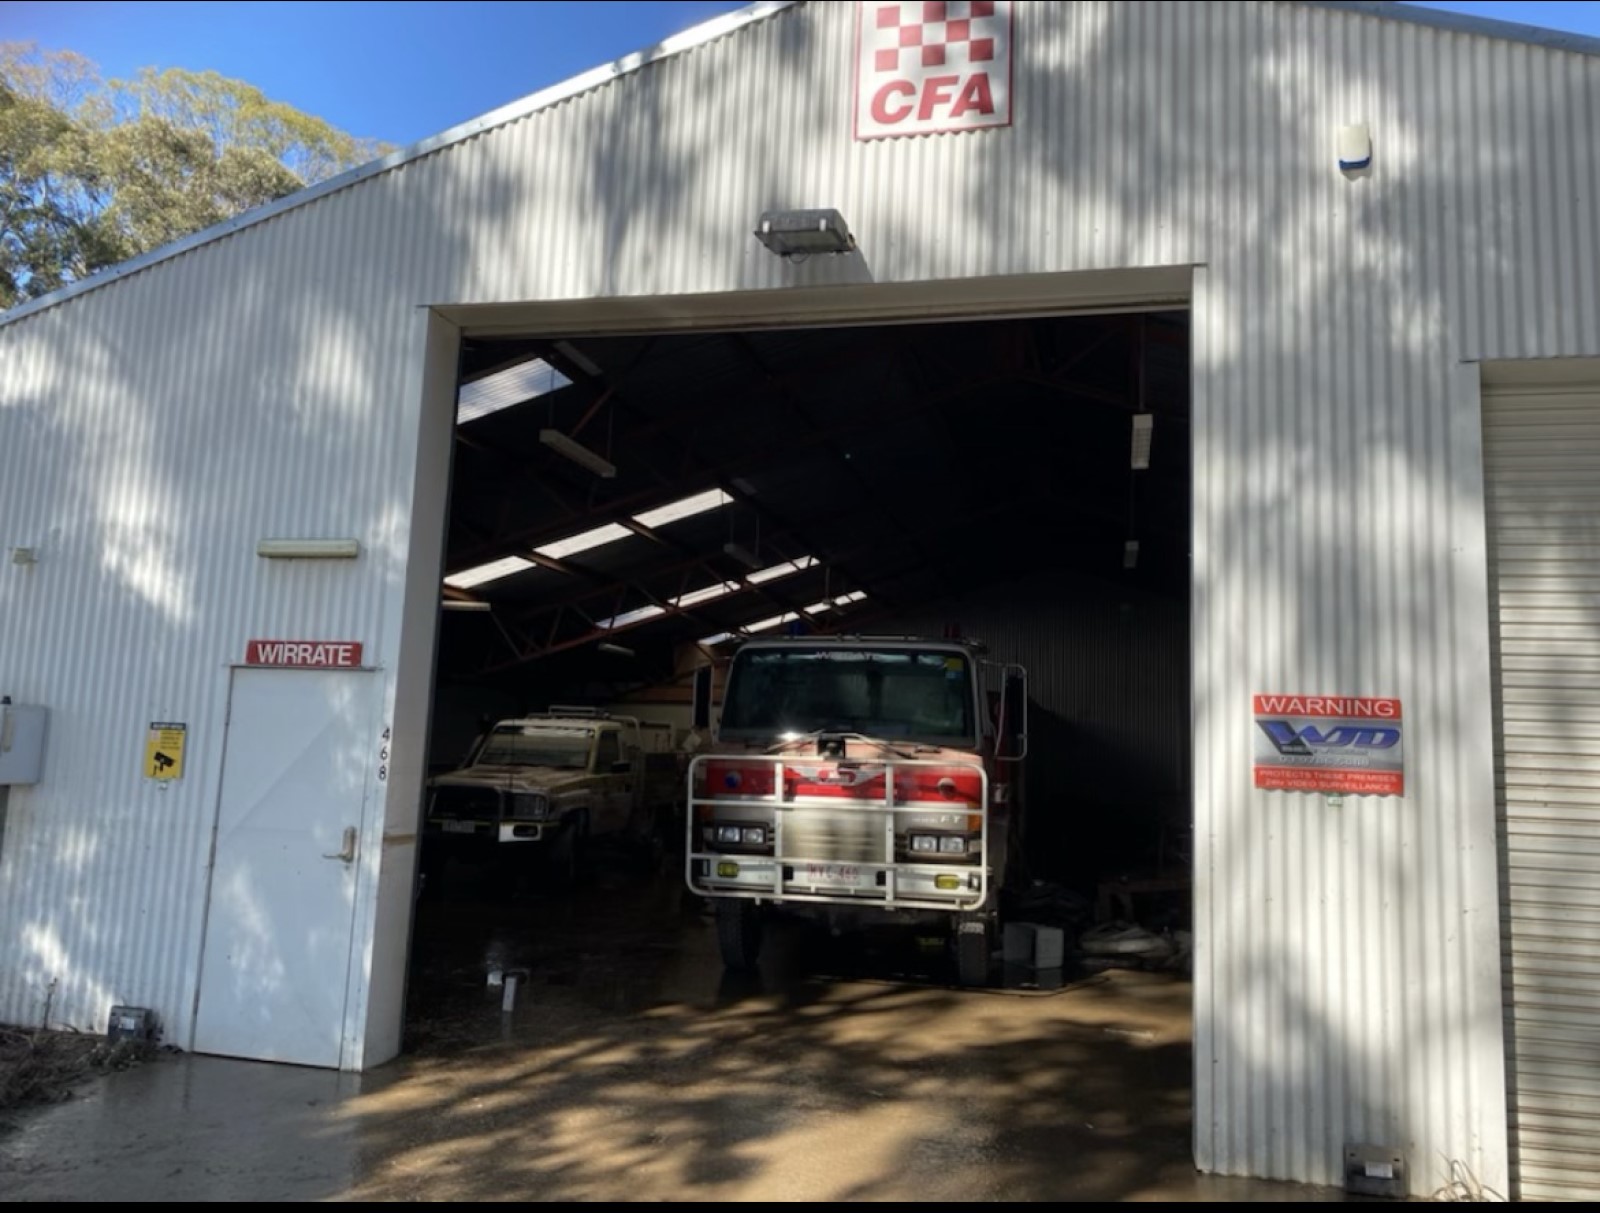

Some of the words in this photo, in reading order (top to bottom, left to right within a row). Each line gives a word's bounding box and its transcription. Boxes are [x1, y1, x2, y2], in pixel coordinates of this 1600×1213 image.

[870, 72, 994, 124] CFA
[257, 643, 353, 666] WIRRATE
[1261, 697, 1394, 716] WARNING
[379, 726, 391, 781] 468
